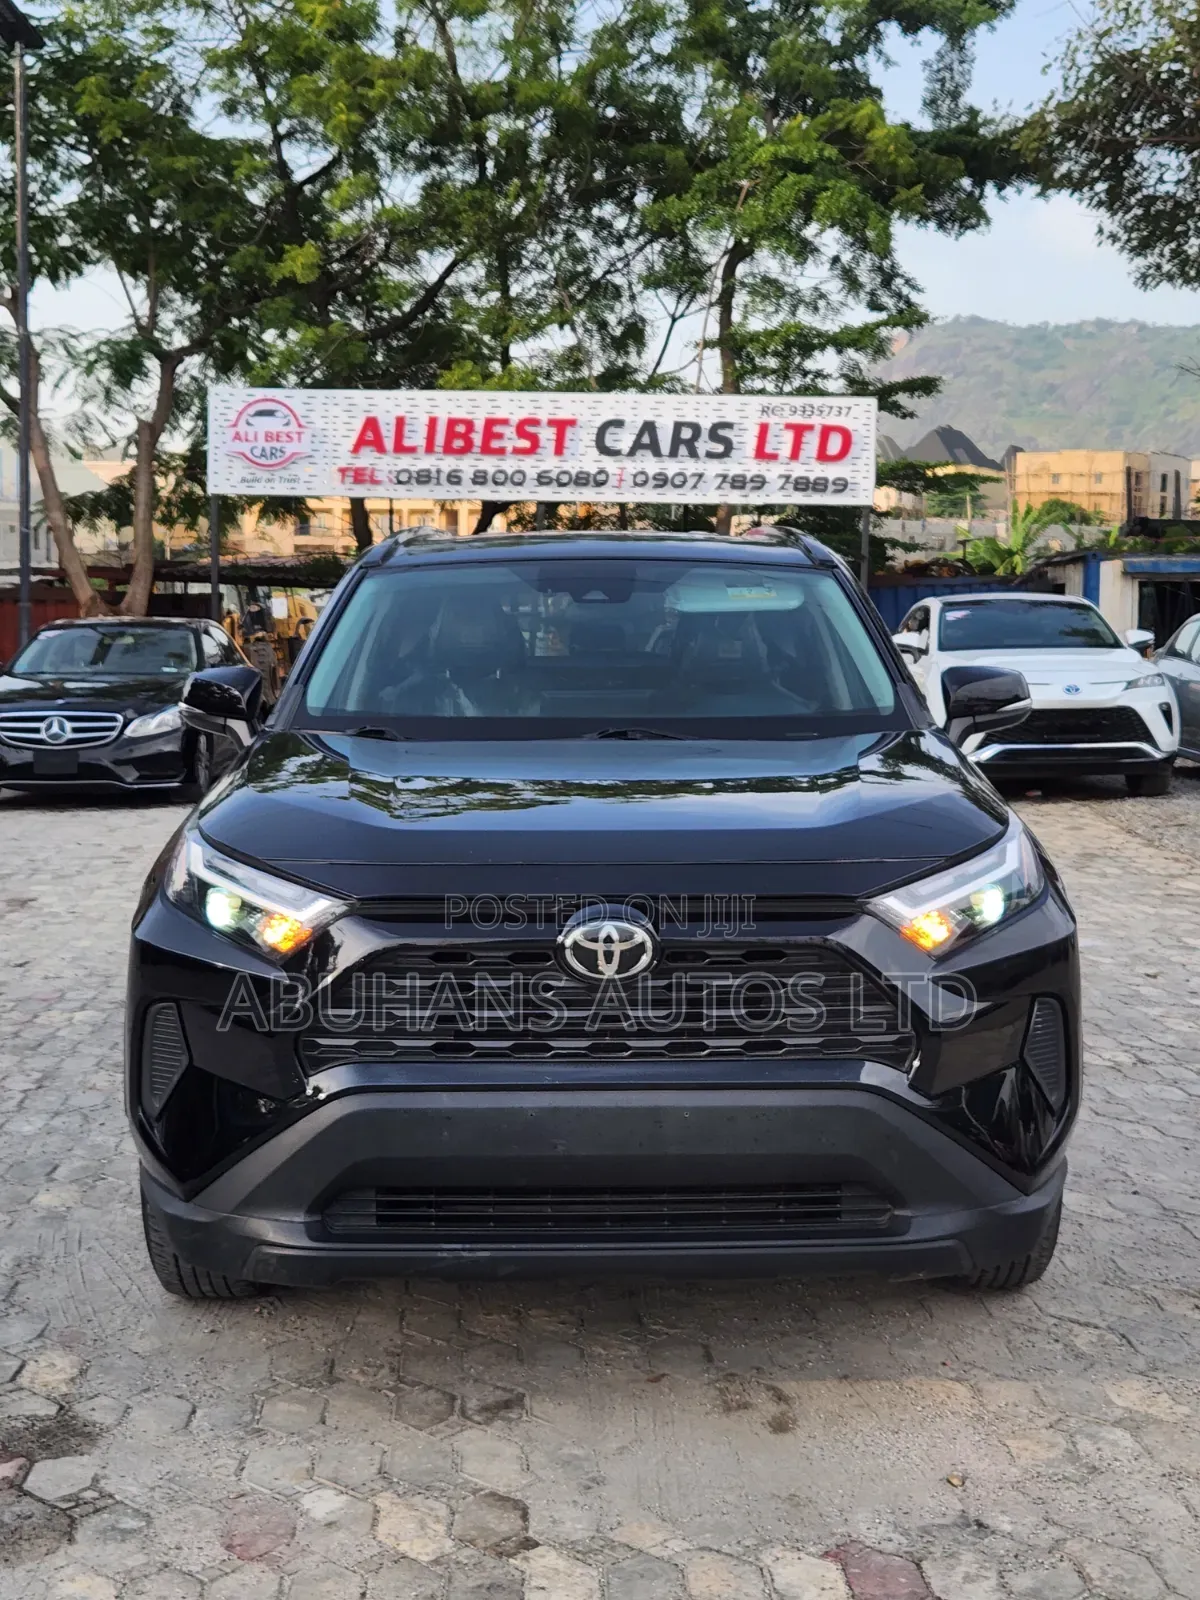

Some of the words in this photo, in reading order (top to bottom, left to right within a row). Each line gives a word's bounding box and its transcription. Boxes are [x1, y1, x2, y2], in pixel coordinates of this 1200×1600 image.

[232, 431, 258, 443] ALI
[264, 431, 305, 443] BEST
[351, 416, 577, 456] ALIBEST
[595, 419, 735, 459] CARS
[753, 421, 853, 463] LTD
[250, 446, 287, 460] CARS
[279, 475, 301, 484] Trust
[396, 468, 463, 486] 0816
[471, 469, 527, 487] 800
[536, 469, 609, 488] 6080
[633, 471, 705, 489] 0907
[714, 473, 767, 491] 789
[777, 474, 849, 493] 7889
